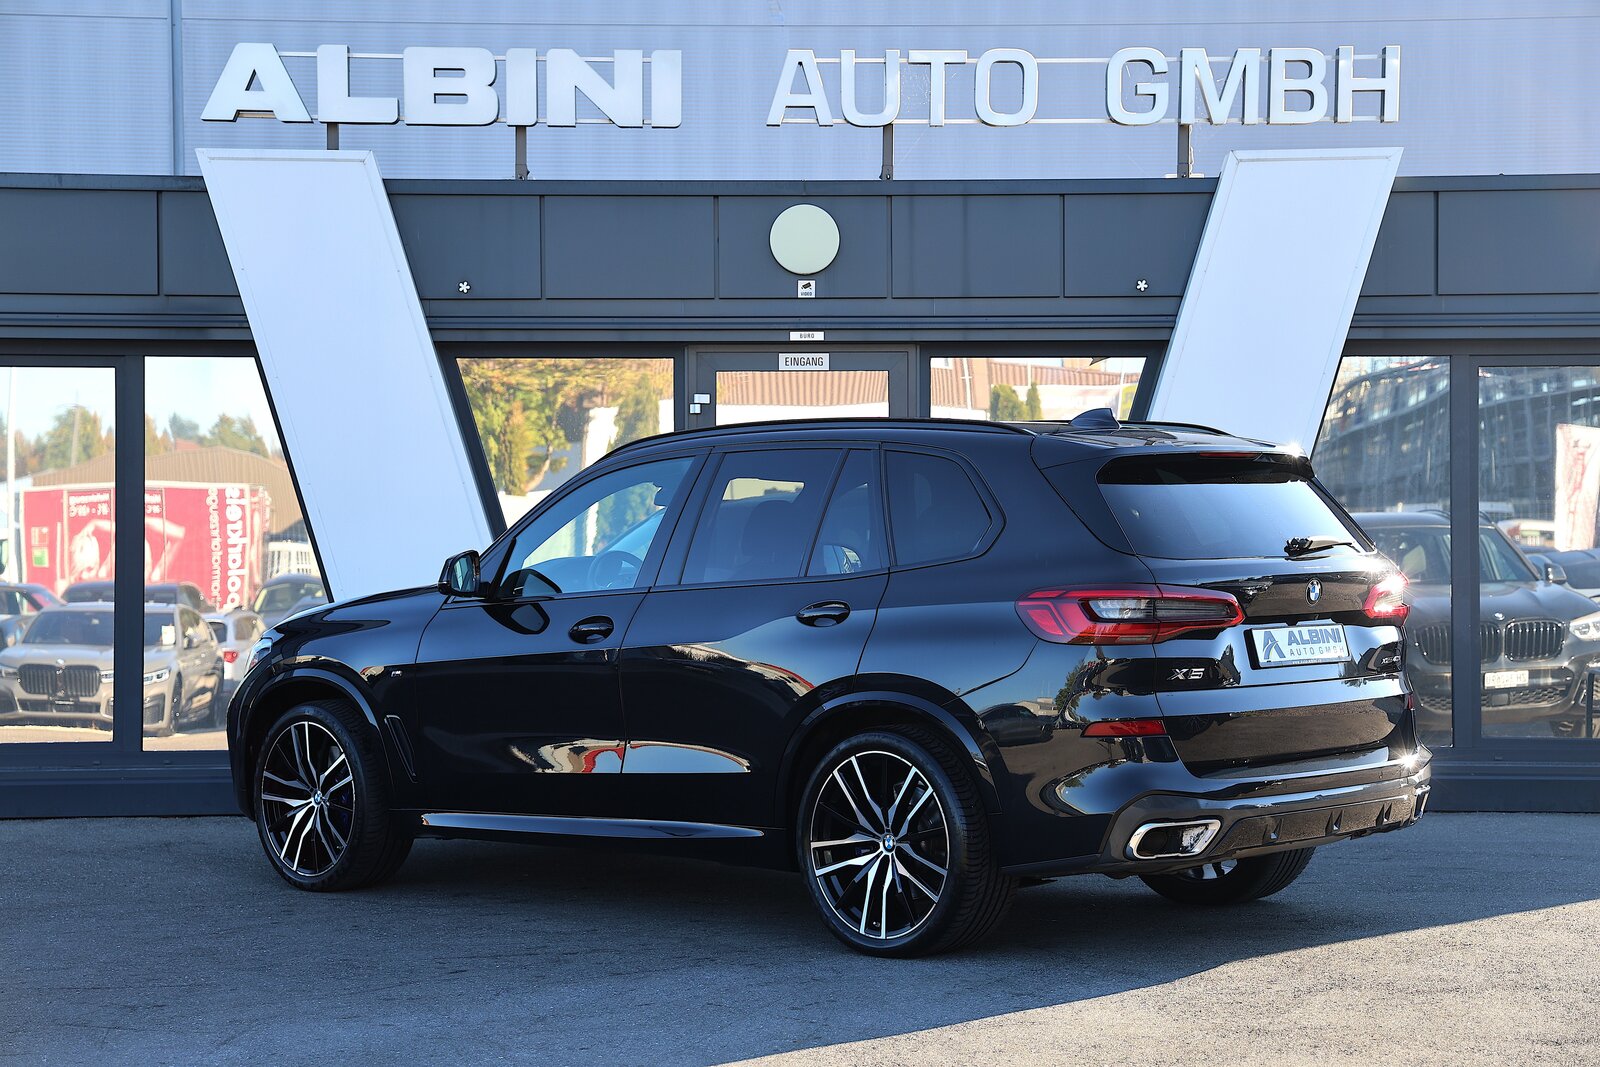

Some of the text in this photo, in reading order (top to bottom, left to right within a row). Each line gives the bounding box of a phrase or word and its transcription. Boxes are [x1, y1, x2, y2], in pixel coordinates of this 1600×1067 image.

[201, 42, 1402, 128] ALBINI AUTO GMBH
[784, 356, 824, 367] EINGANG
[1287, 628, 1342, 646] ALBINI
[1289, 647, 1315, 657] AUTO
[1167, 667, 1206, 681] X5
